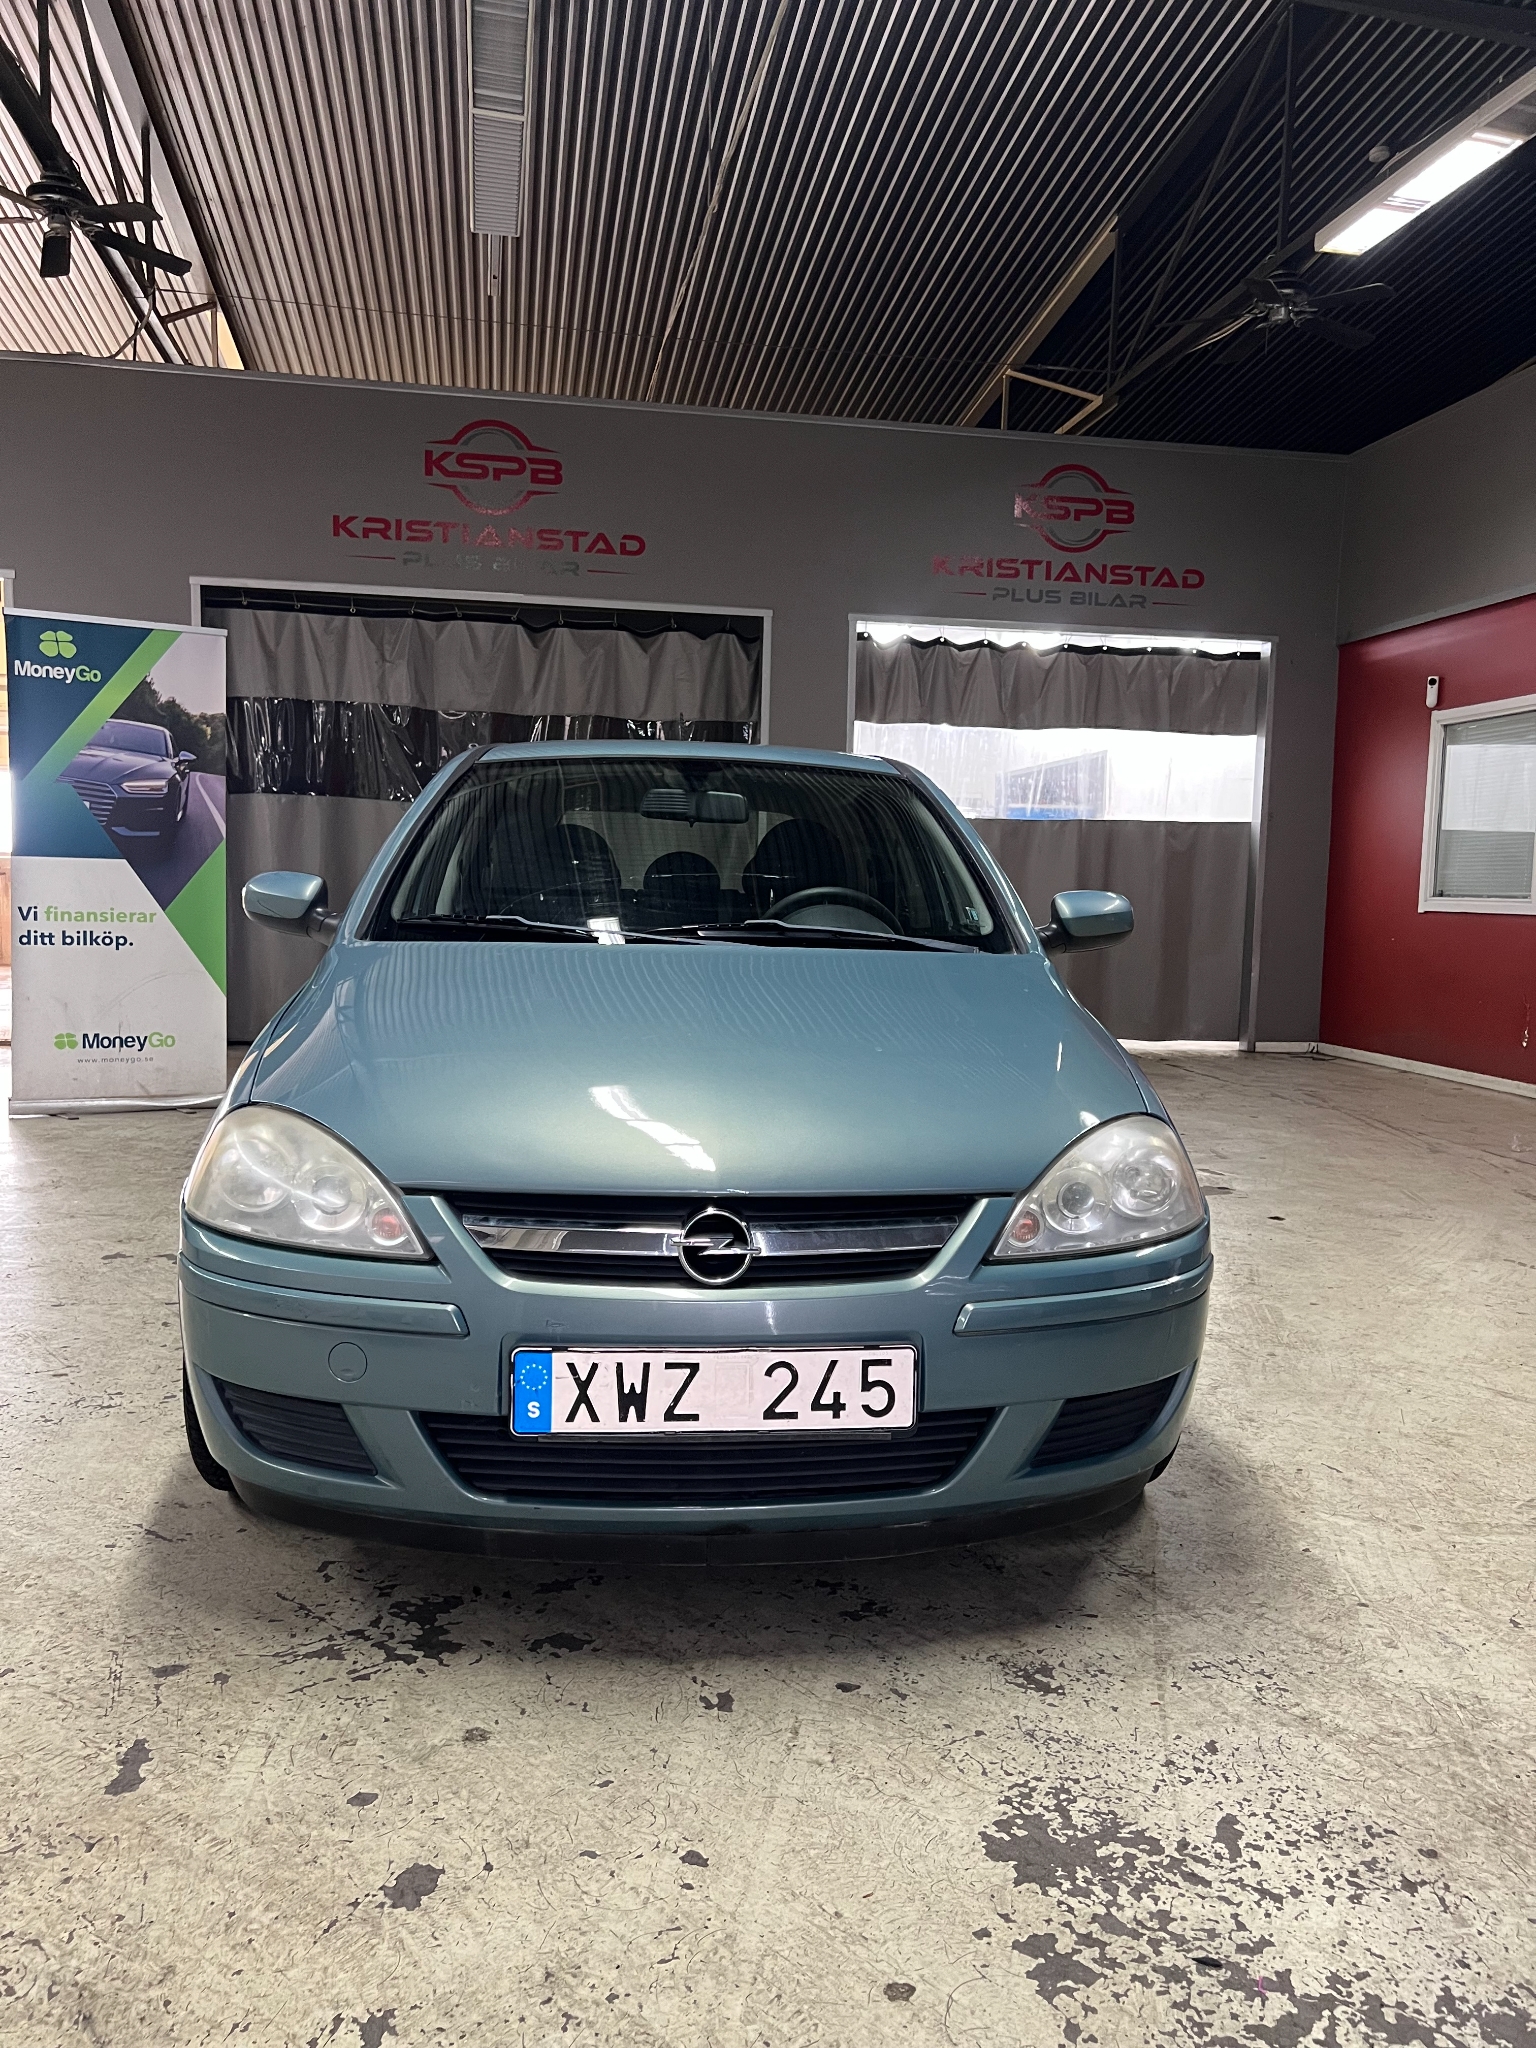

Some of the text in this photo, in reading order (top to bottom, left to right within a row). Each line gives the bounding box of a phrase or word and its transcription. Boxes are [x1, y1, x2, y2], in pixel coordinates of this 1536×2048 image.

[424, 449, 564, 486] KSPB
[1013, 491, 1136, 526] KSPB
[332, 514, 647, 557] KRISTIANSTAD
[930, 554, 1206, 590] KRISTIANSTAD
[992, 586, 1148, 610] PLUS BILAR
[14, 659, 102, 684] MoneyGo
[17, 905, 157, 924] Vi finansierar
[18, 929, 135, 951] ditt bilköp.
[82, 1031, 176, 1052] MoneyGo
[77, 1056, 154, 1064] www.moneygo.se
[564, 1359, 897, 1423] XWZ 245
[526, 1401, 541, 1418] S
